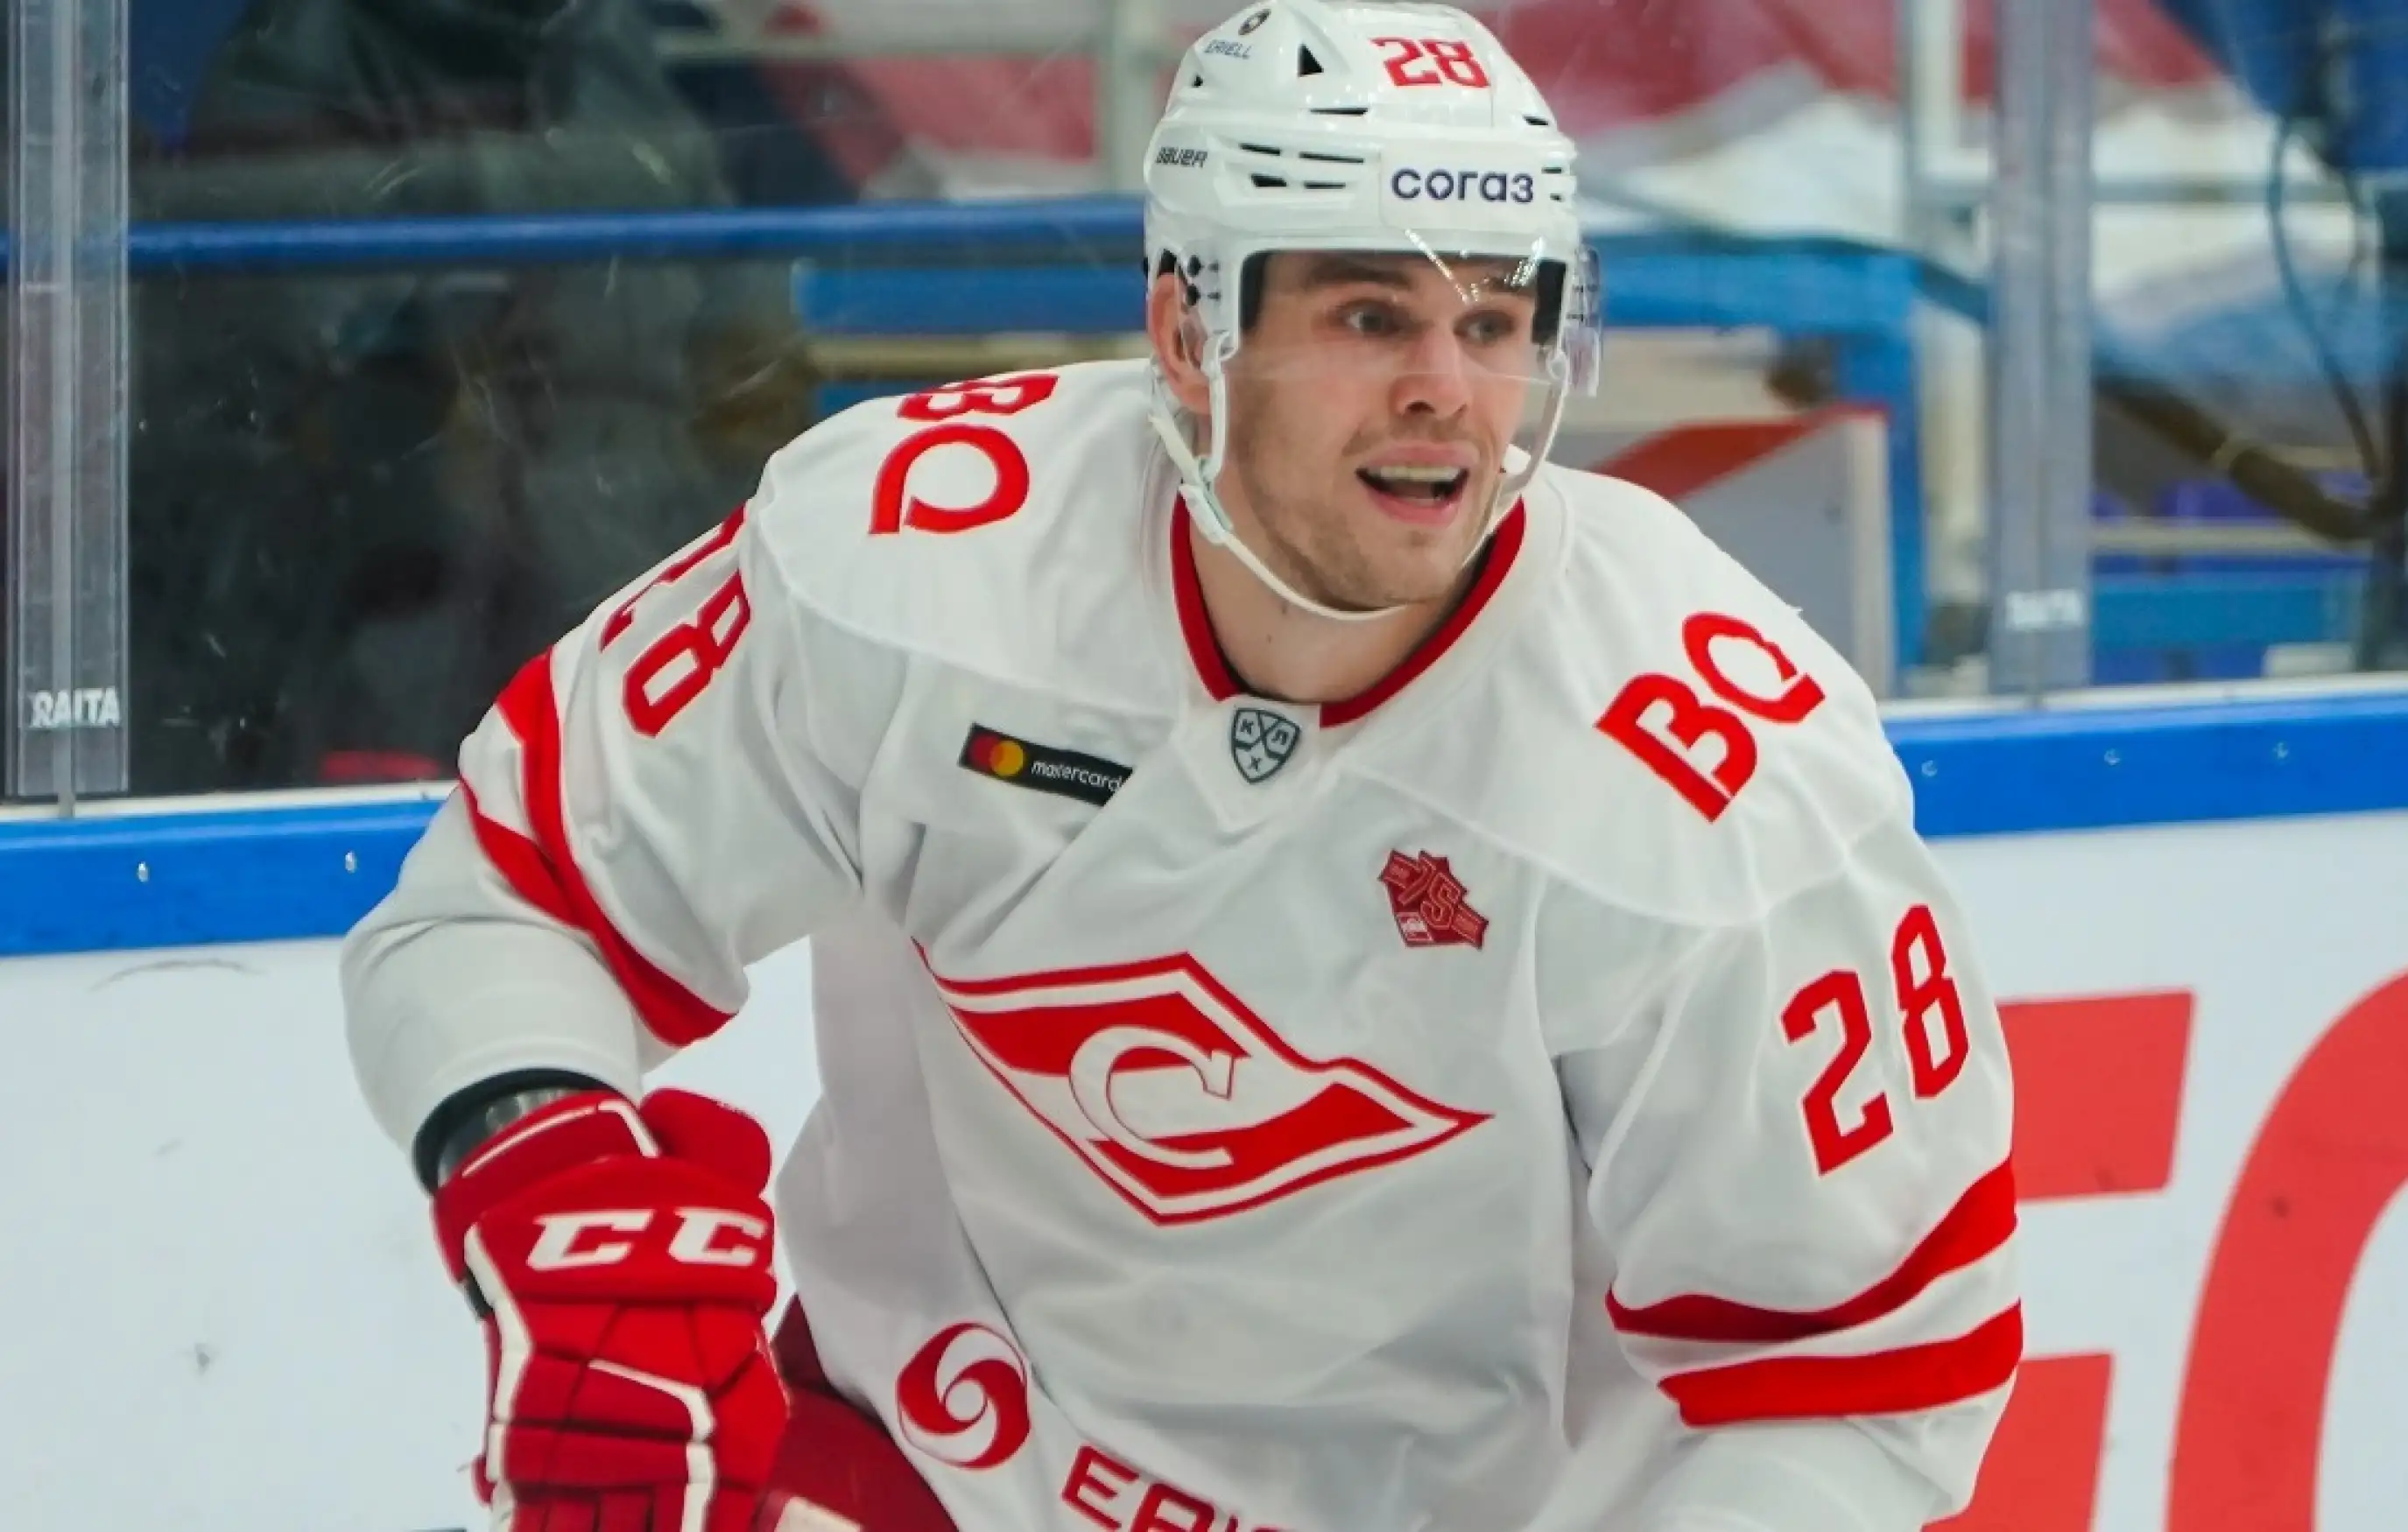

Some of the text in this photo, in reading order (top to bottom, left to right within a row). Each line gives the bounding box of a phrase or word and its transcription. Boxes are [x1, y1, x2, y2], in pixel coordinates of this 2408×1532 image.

[1370, 37, 1491, 88] 28
[1391, 167, 1534, 204] согаз
[1593, 611, 1827, 823] BQ
[1780, 903, 1970, 1177] 28
[1060, 1444, 1298, 1532] ER
